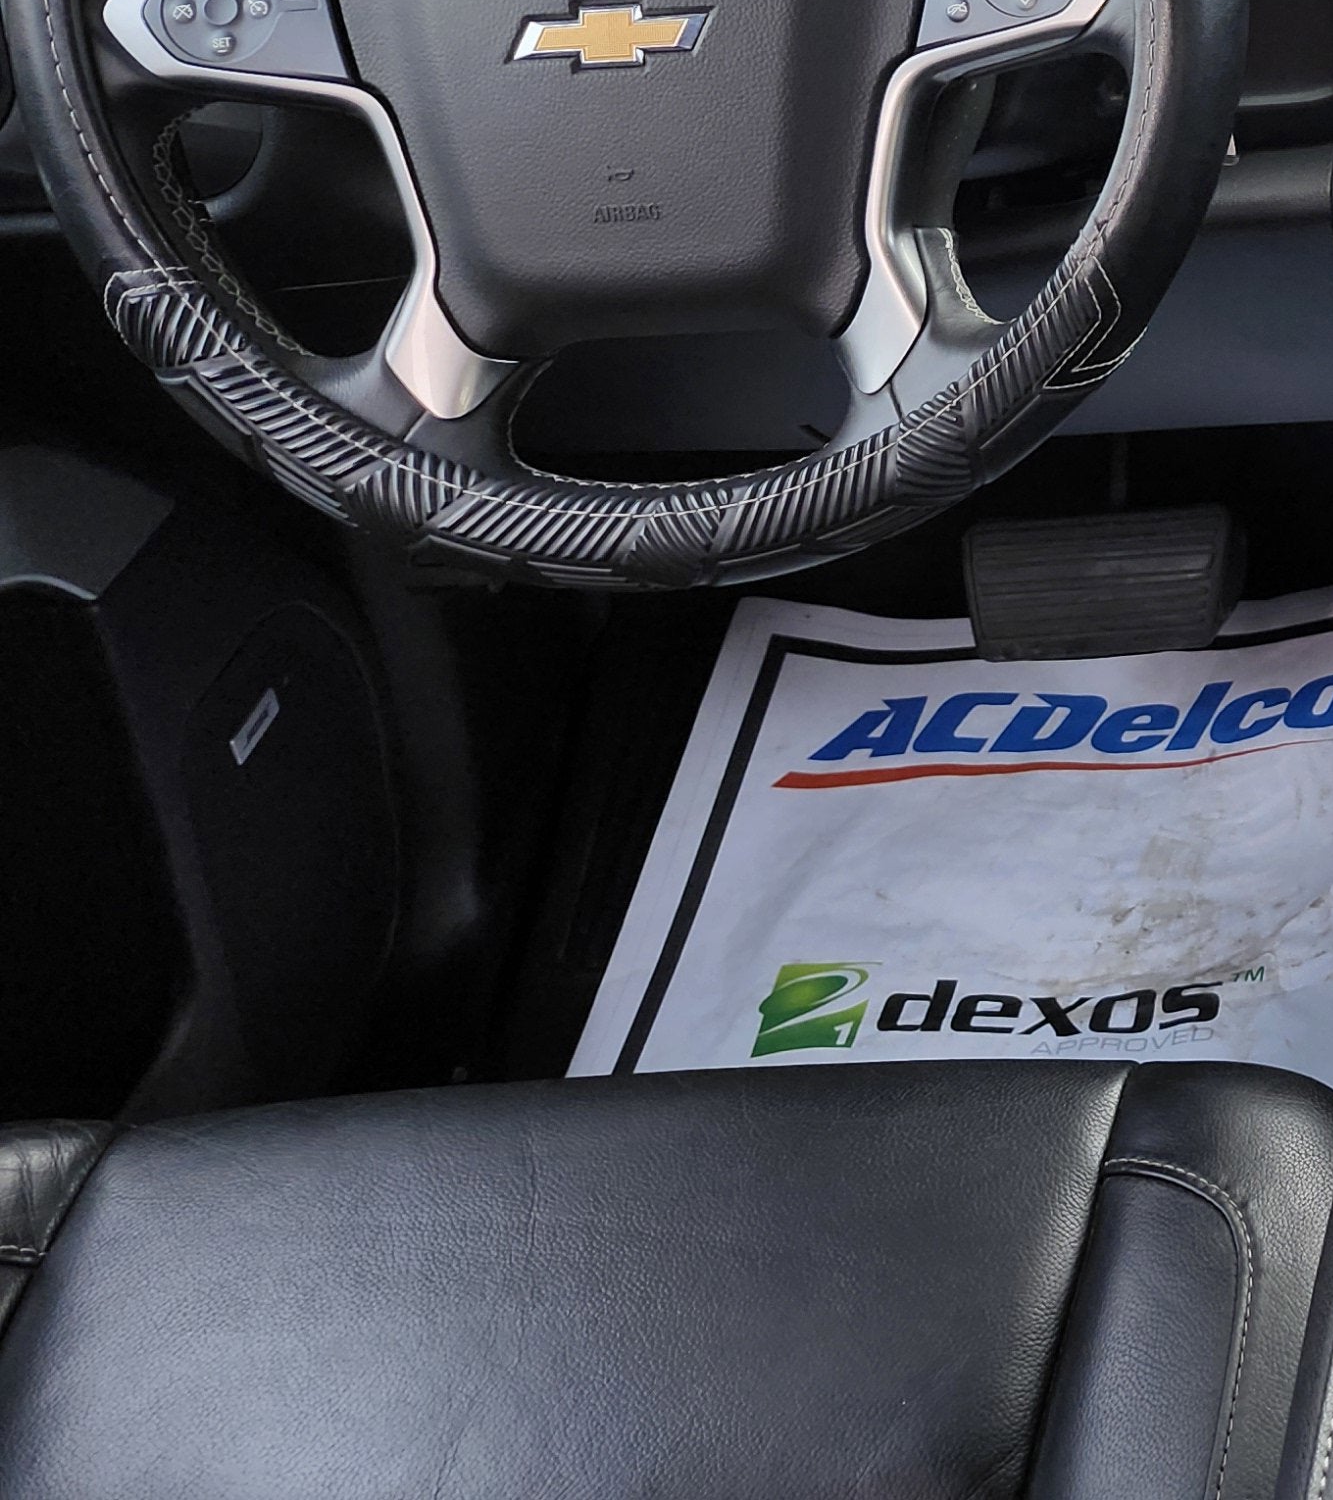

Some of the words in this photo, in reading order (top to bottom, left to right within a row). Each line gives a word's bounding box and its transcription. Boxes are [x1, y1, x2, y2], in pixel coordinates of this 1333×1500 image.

[212, 36, 231, 48] SET
[593, 203, 662, 225] AIRBAG
[876, 980, 1225, 1038] dexos
[1029, 1026, 1215, 1057] APPROVED
